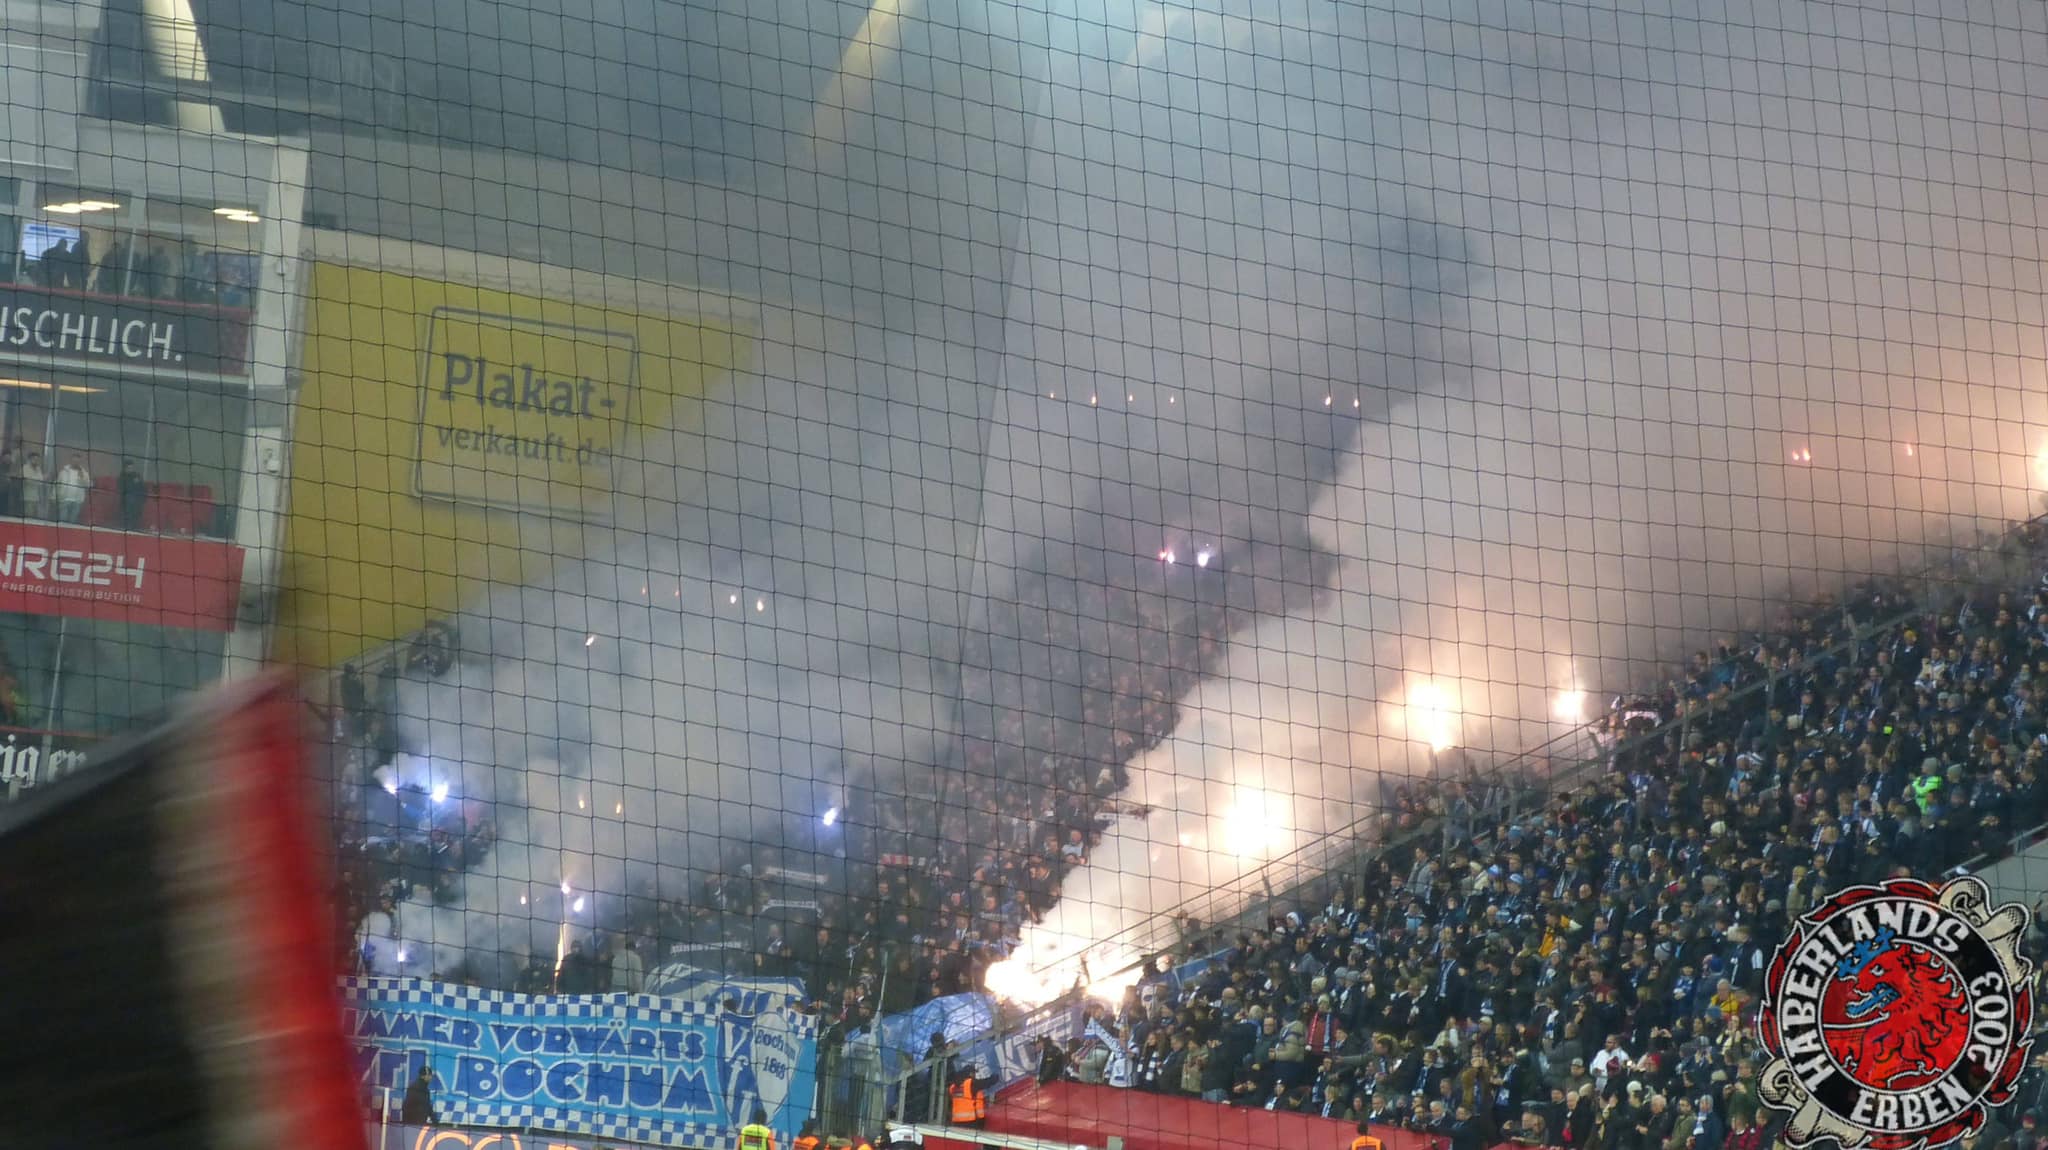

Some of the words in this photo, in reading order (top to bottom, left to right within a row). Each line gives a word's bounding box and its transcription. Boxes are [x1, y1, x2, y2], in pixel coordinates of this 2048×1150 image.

[439, 352, 616, 420] Plakat-
[435, 424, 609, 467] verkauft.de
[343, 1007, 481, 1050] IMMER
[488, 1018, 707, 1063] VORWÄRTS
[451, 1051, 717, 1115] BOCHUM
